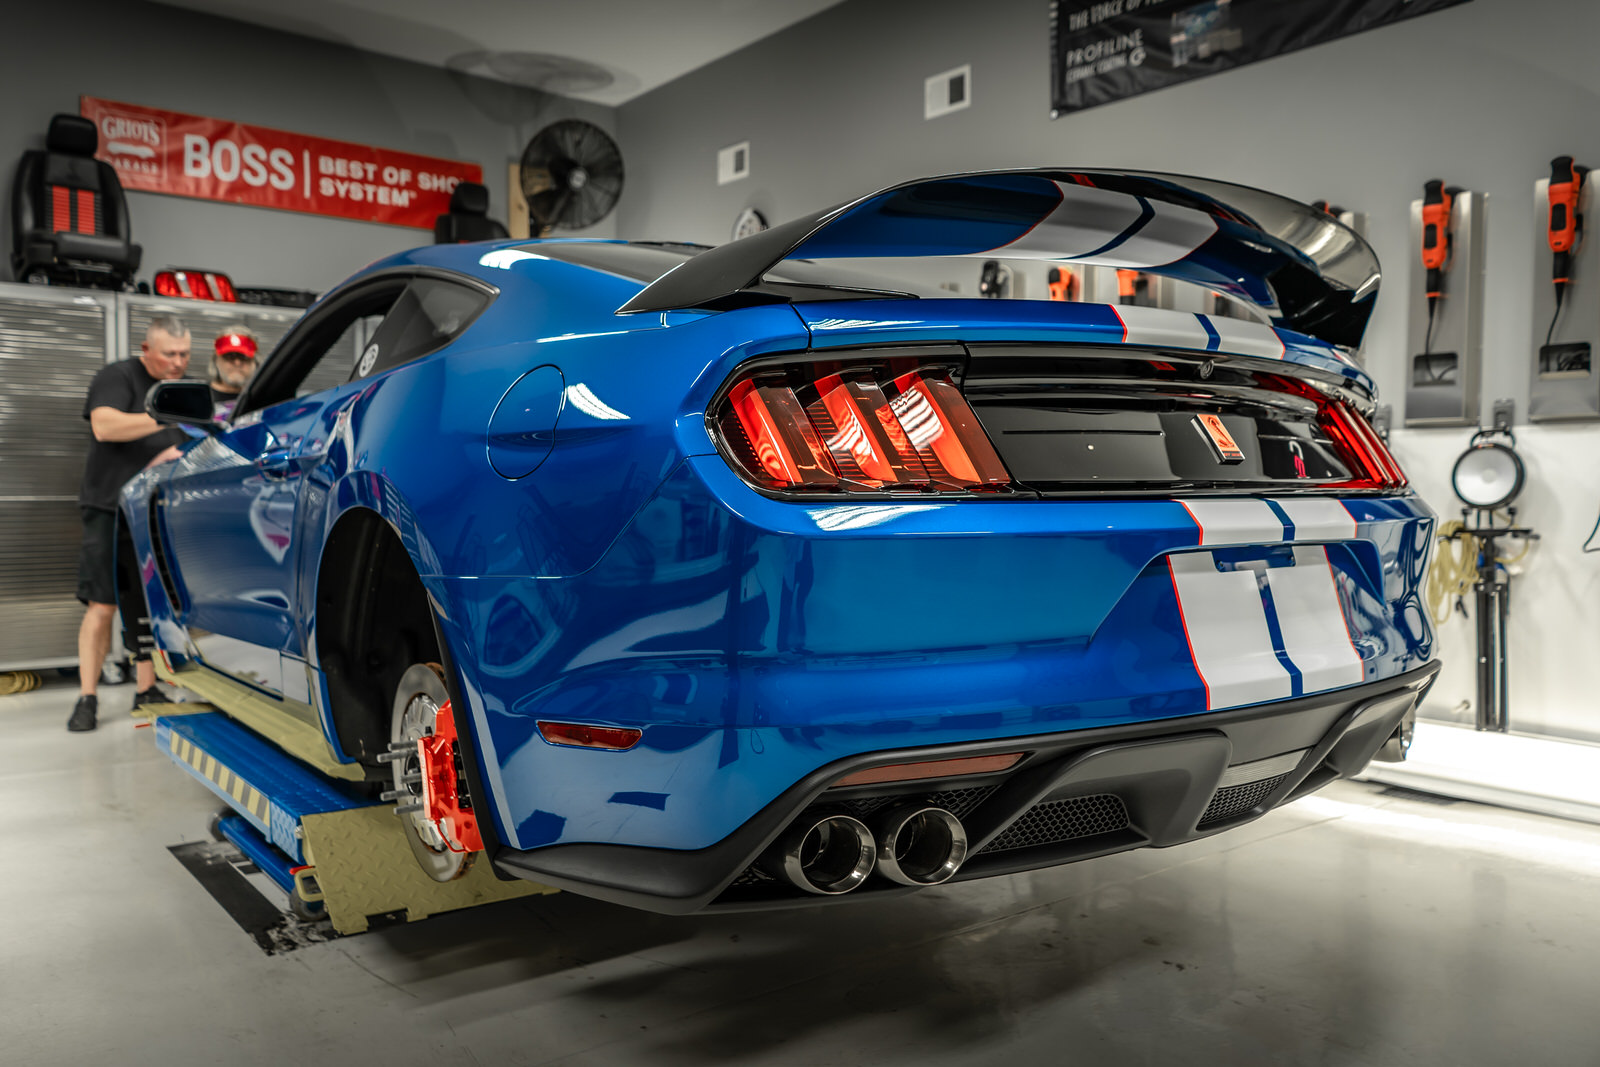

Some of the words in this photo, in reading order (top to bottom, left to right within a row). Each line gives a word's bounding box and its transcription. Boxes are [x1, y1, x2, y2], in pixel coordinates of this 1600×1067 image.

[1066, 28, 1143, 68] PROFILINE
[184, 134, 295, 191] BOSS
[318, 155, 378, 182] BEST
[383, 165, 412, 186] OF
[417, 171, 464, 195] SHO
